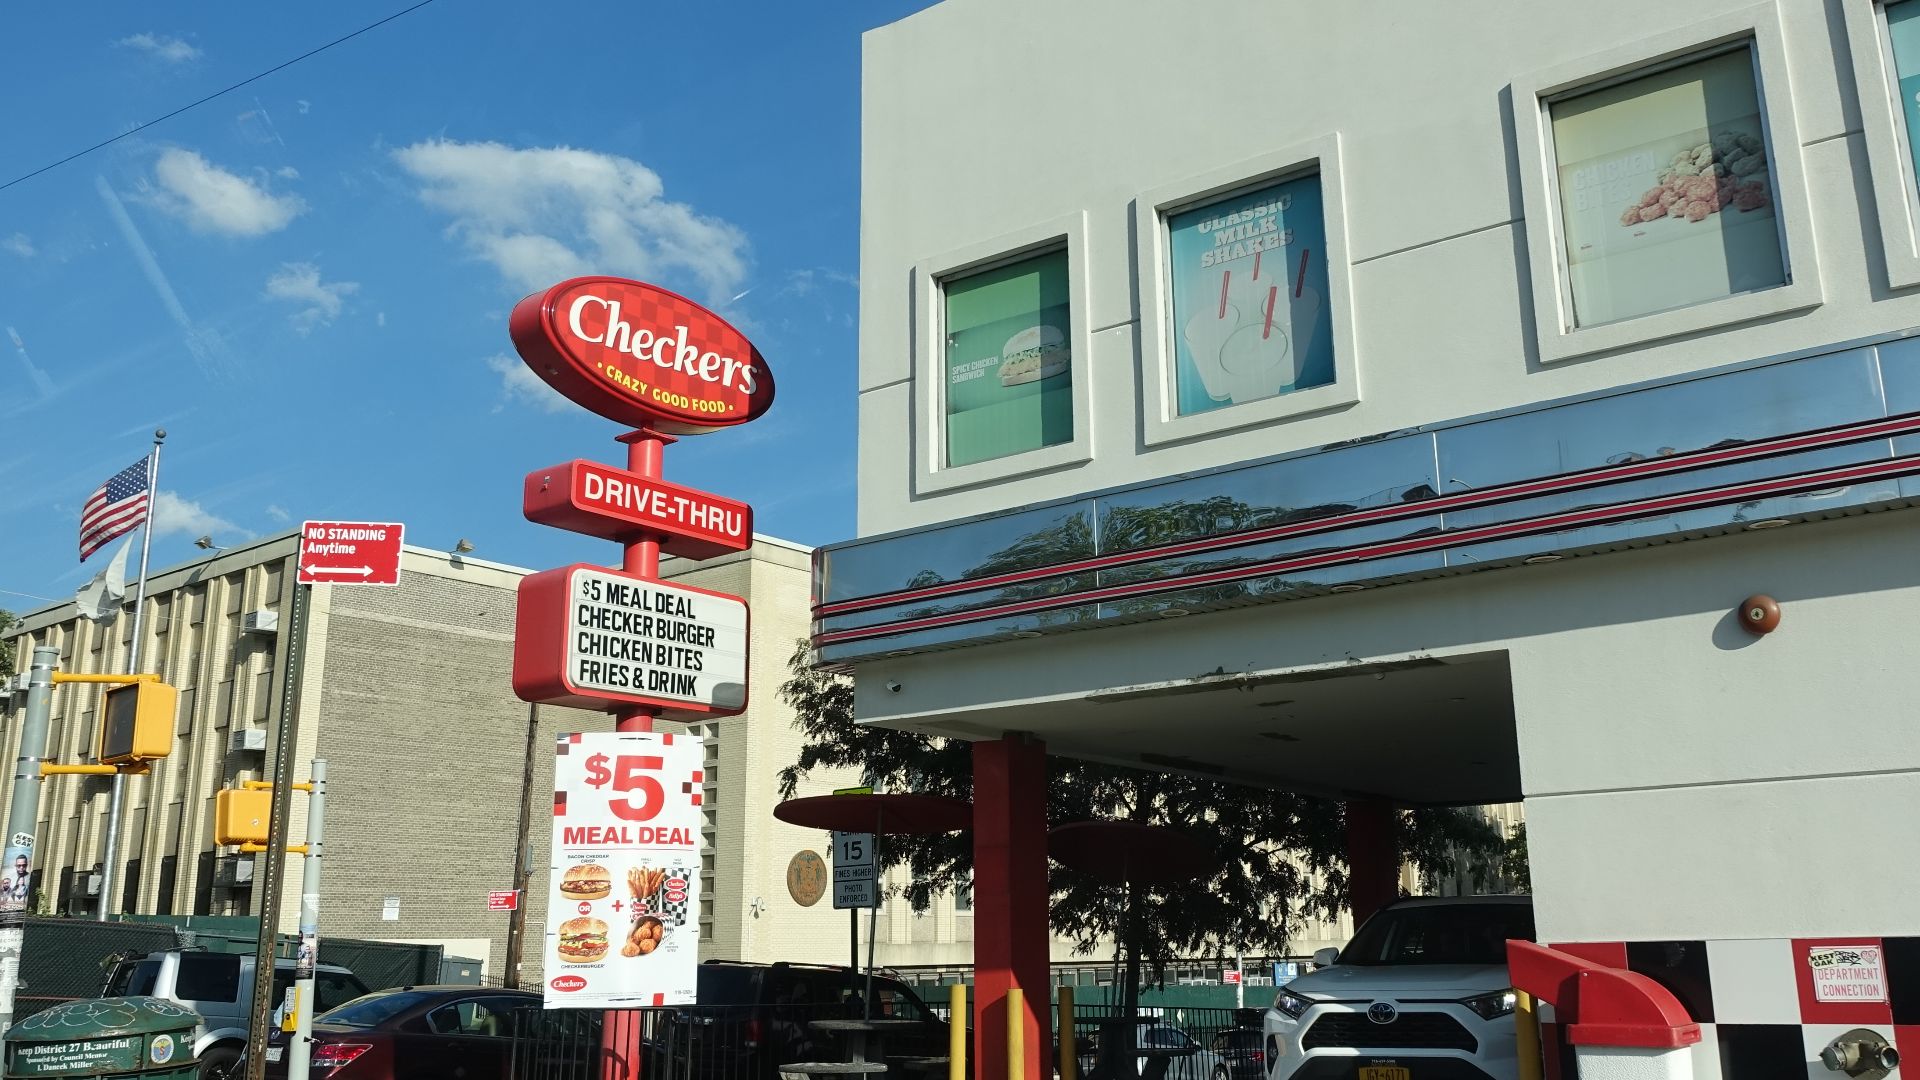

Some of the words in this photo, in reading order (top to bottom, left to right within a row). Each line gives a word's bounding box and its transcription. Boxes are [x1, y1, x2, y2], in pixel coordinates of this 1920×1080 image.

[1198, 193, 1292, 234] CLASSIC
[1215, 216, 1278, 247] MILK
[1201, 228, 1294, 269] SHAKES
[569, 294, 758, 395] Checkers
[952, 362, 971, 375] SPICY
[971, 356, 999, 370] CHICKEN
[952, 368, 985, 384] SANDWICH
[606, 364, 648, 395] CRAZY
[652, 388, 689, 410] GOOD
[691, 398, 726, 413] FOOD
[585, 472, 742, 537] DRIVE-THRU
[308, 528, 325, 540] NO
[328, 529, 386, 541] STANDING
[307, 542, 356, 556] Anytime
[583, 579, 601, 601] $5
[606, 582, 653, 612] MEAL
[655, 592, 696, 620] DEAL
[578, 604, 654, 638] CHECKER
[656, 618, 715, 648] BURGER
[578, 631, 653, 664] CHICKEN
[655, 644, 703, 672] BITES
[579, 659, 629, 687] FRIES
[632, 667, 645, 690] &
[649, 669, 697, 697] DRINK
[584, 752, 665, 822] $5
[563, 826, 633, 845] MEAL
[638, 827, 695, 845] DEAL
[843, 840, 863, 861] 15
[835, 870, 851, 878] FINES
[852, 868, 871, 877] HIGHER
[844, 884, 863, 893] PHOTO
[839, 895, 868, 904] ENFORCED
[1810, 952, 1834, 962] KEST
[1817, 968, 1878, 980] DEPARTMENT
[553, 980, 585, 988] Checkers
[1822, 984, 1880, 997] CONNECTION
[34, 1044, 67, 1055] District
[68, 1042, 81, 1053] 27
[59, 1053, 83, 1062] Council
[69, 1061, 93, 1069] Miller
